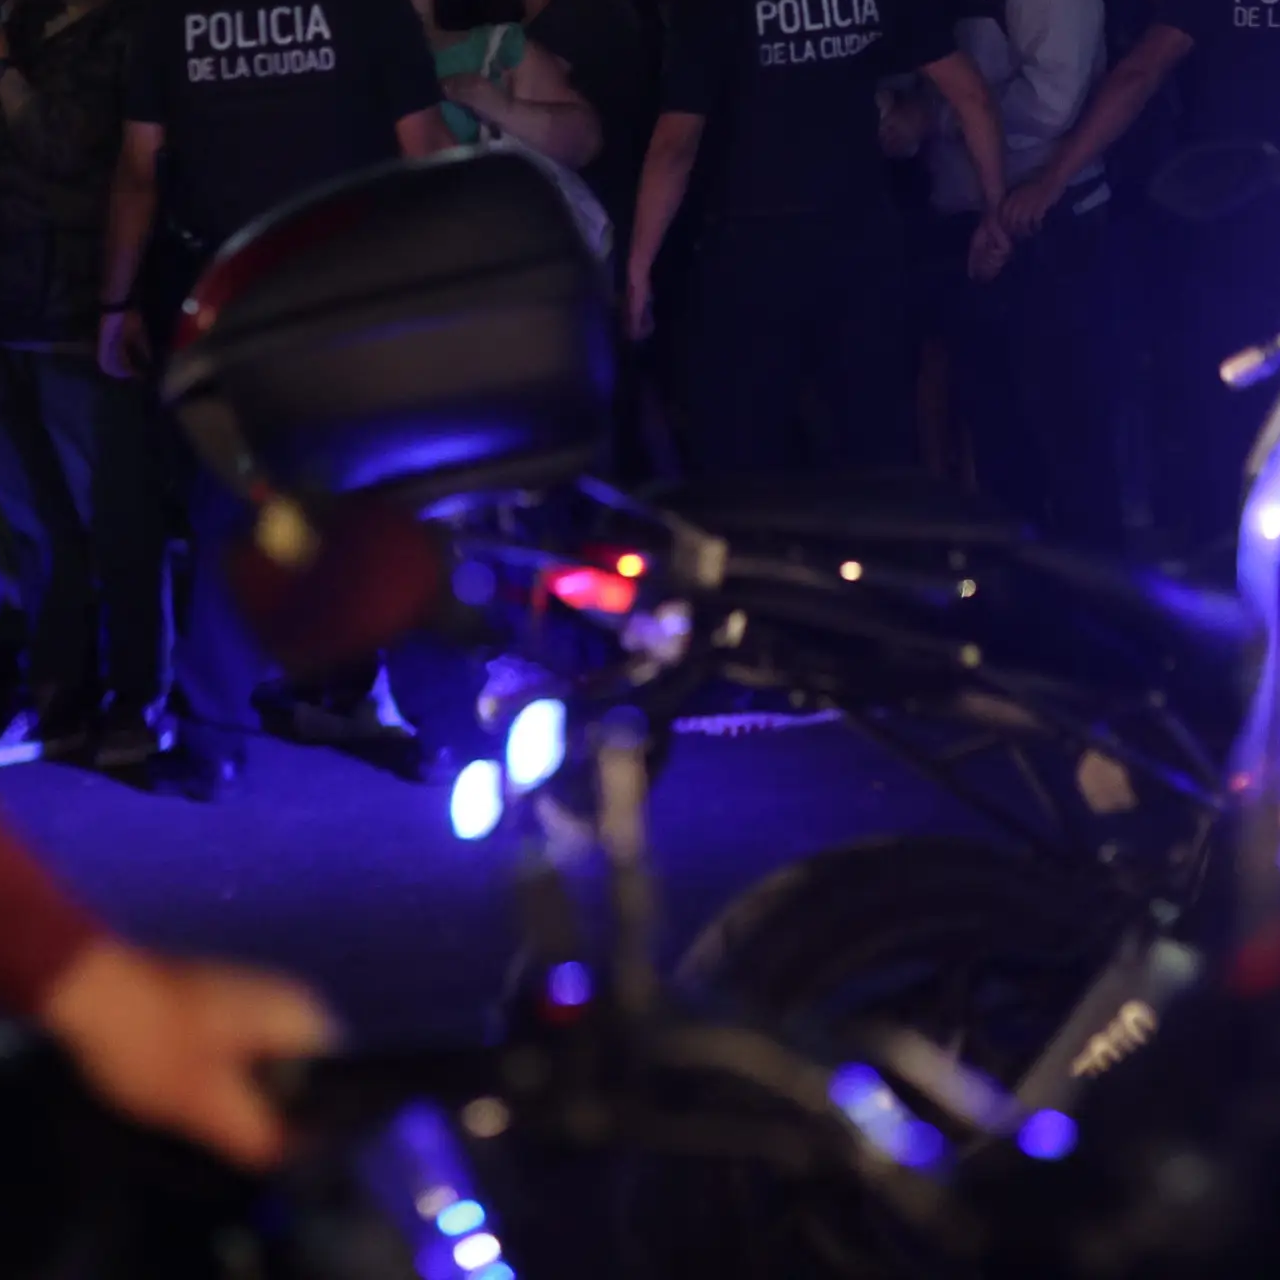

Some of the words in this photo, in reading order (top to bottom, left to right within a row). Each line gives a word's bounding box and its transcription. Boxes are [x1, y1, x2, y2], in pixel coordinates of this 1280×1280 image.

[184, 4, 332, 53] POLICIA
[1233, 5, 1261, 28] DE
[187, 57, 218, 83] DE
[220, 55, 252, 80] LA
[253, 46, 336, 77] CIUDAD
[759, 42, 787, 67] DE
[789, 39, 817, 64] LA
